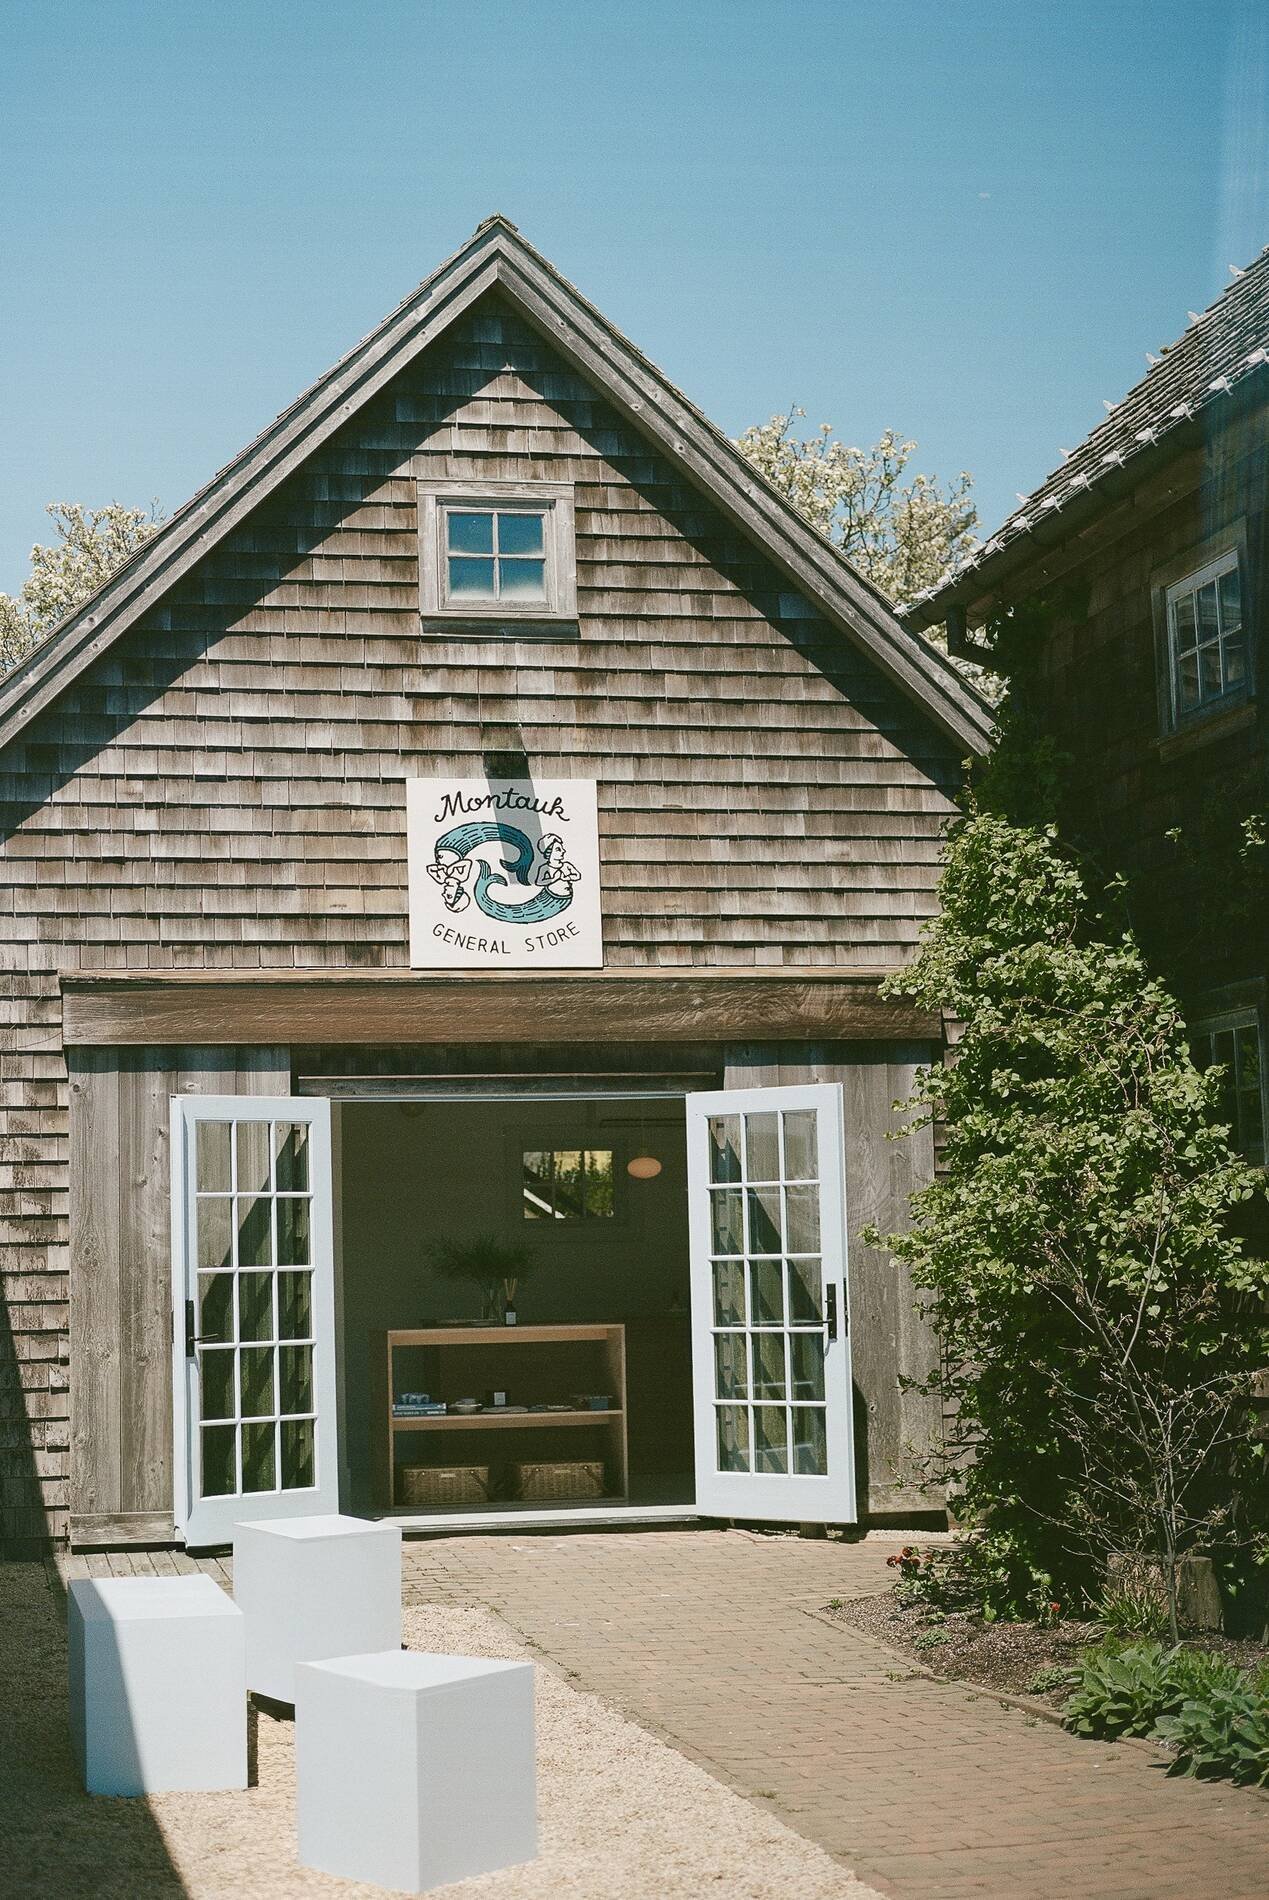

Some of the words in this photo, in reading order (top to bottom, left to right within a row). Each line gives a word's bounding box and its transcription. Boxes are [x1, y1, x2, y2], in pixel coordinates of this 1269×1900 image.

[434, 787, 570, 823] Montauk
[432, 923, 511, 954] GENERAL
[524, 921, 580, 952] STORE
